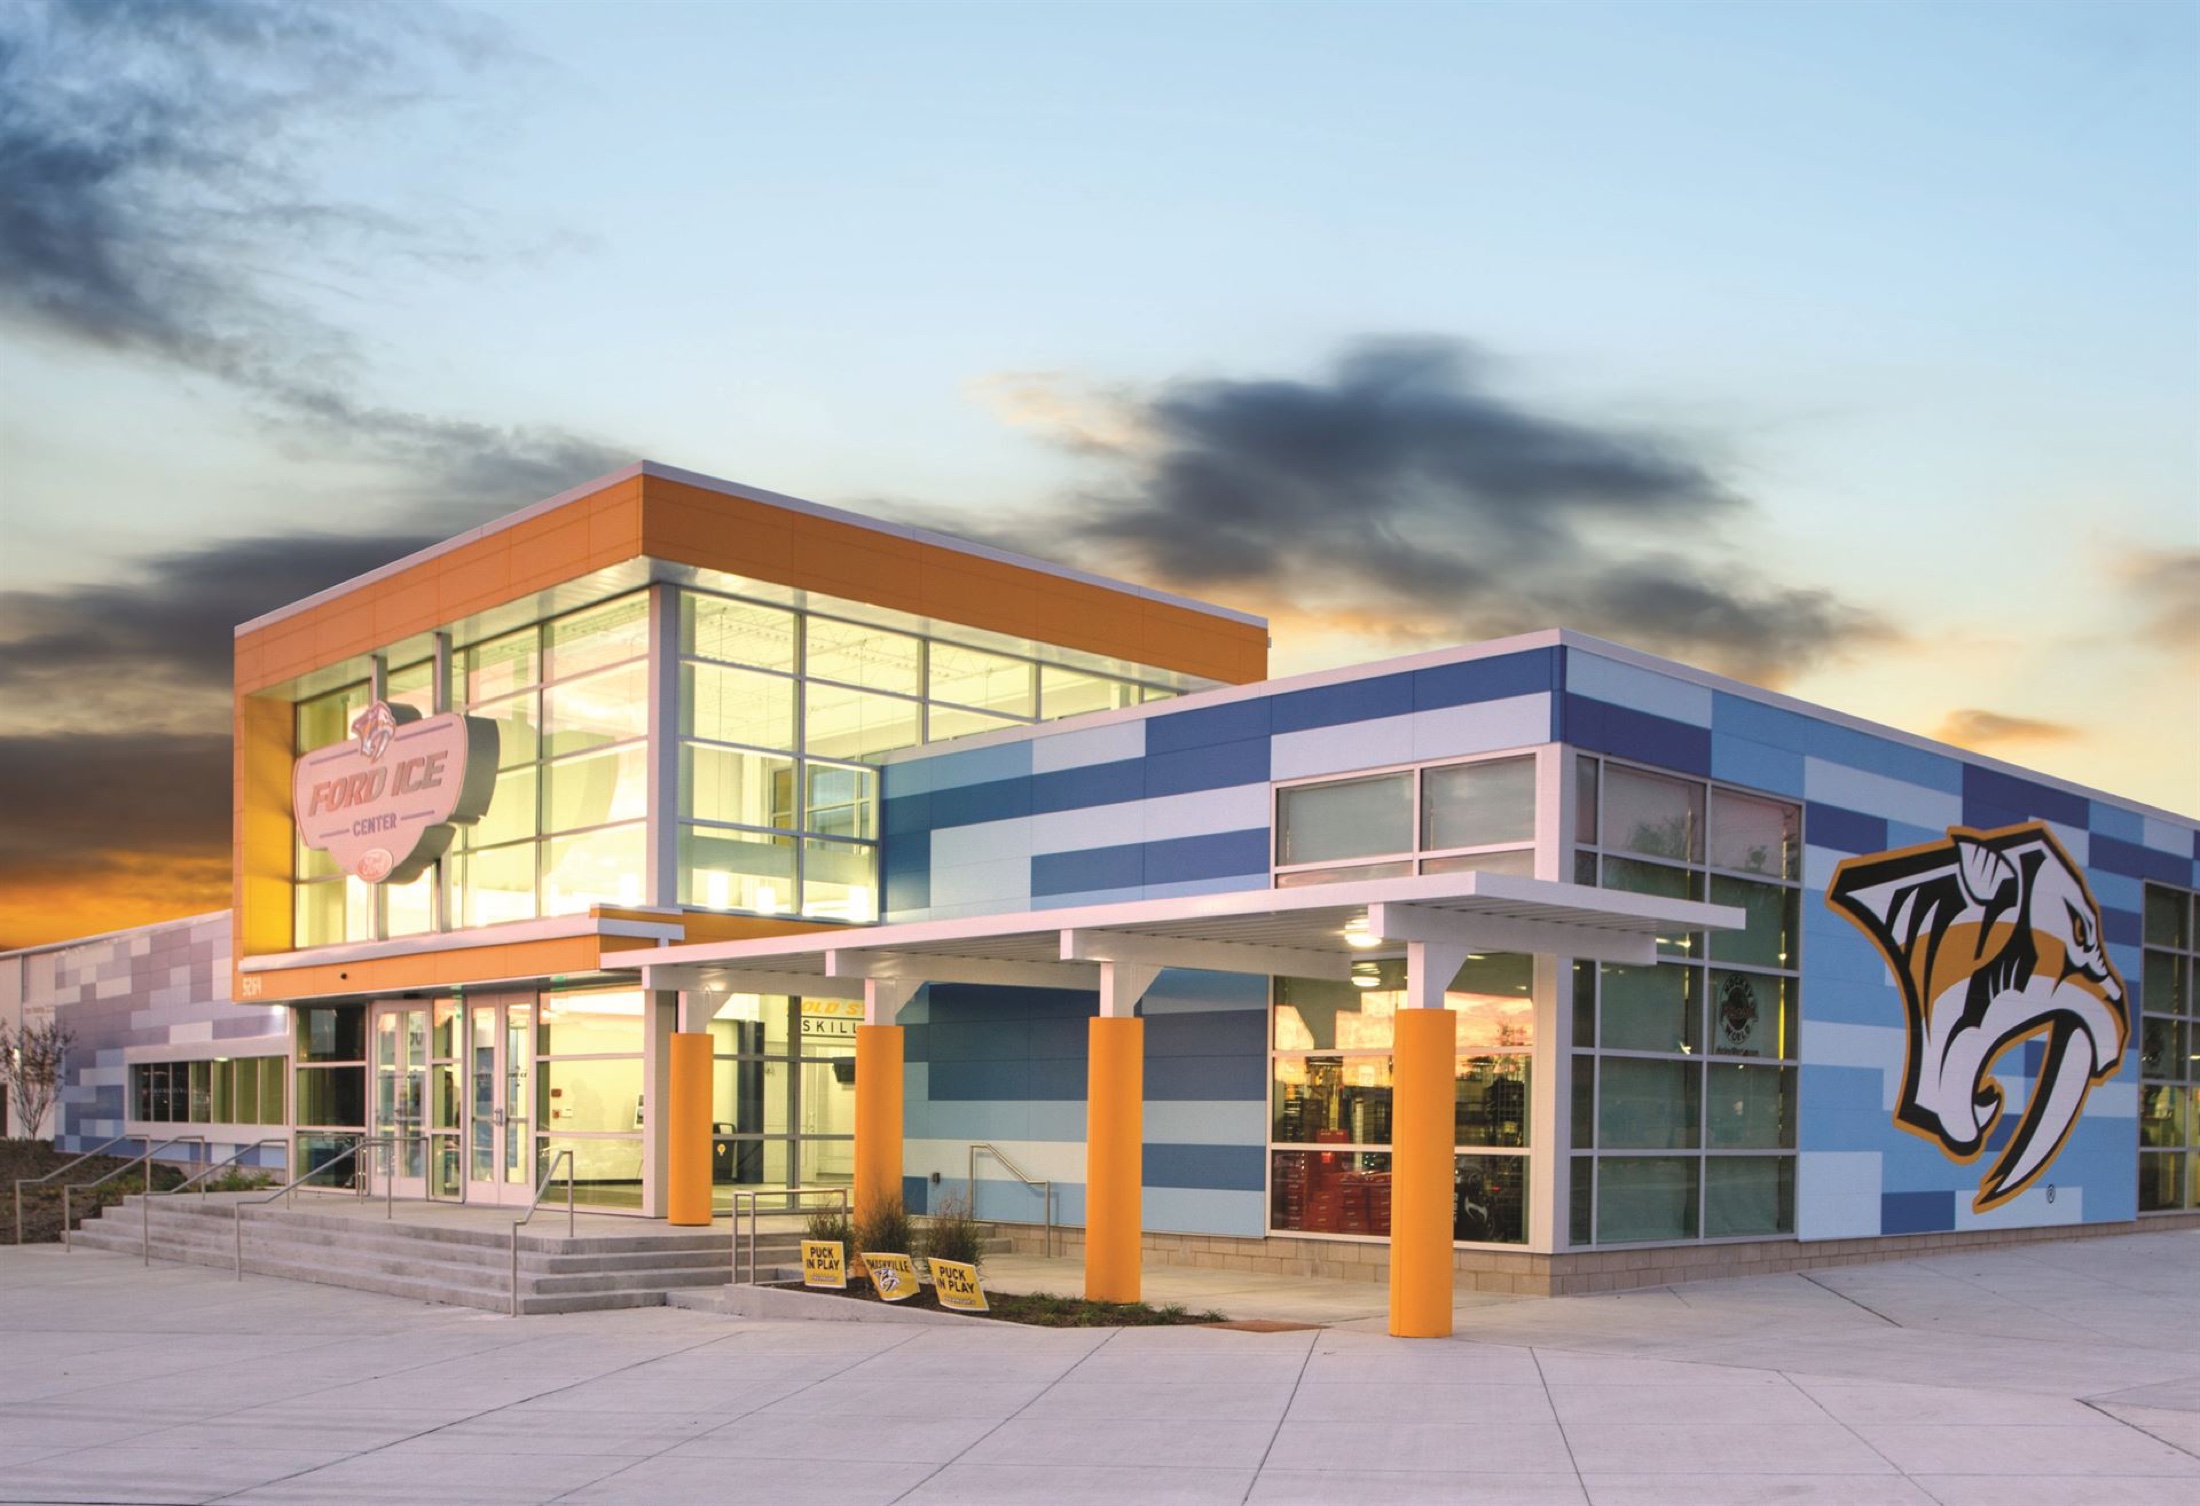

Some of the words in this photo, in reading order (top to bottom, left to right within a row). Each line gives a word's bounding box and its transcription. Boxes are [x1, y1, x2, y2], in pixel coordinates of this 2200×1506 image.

[308, 766, 387, 817] FORD
[391, 750, 448, 797] ICE
[353, 812, 397, 837] CENTER
[802, 1001, 840, 1014] OLD
[810, 1246, 834, 1258] PUCK
[806, 1259, 815, 1269] IN
[817, 1259, 840, 1270] PLAY
[939, 1266, 966, 1281] PUCK
[938, 1278, 946, 1290] IN
[948, 1281, 975, 1293] PLAY
